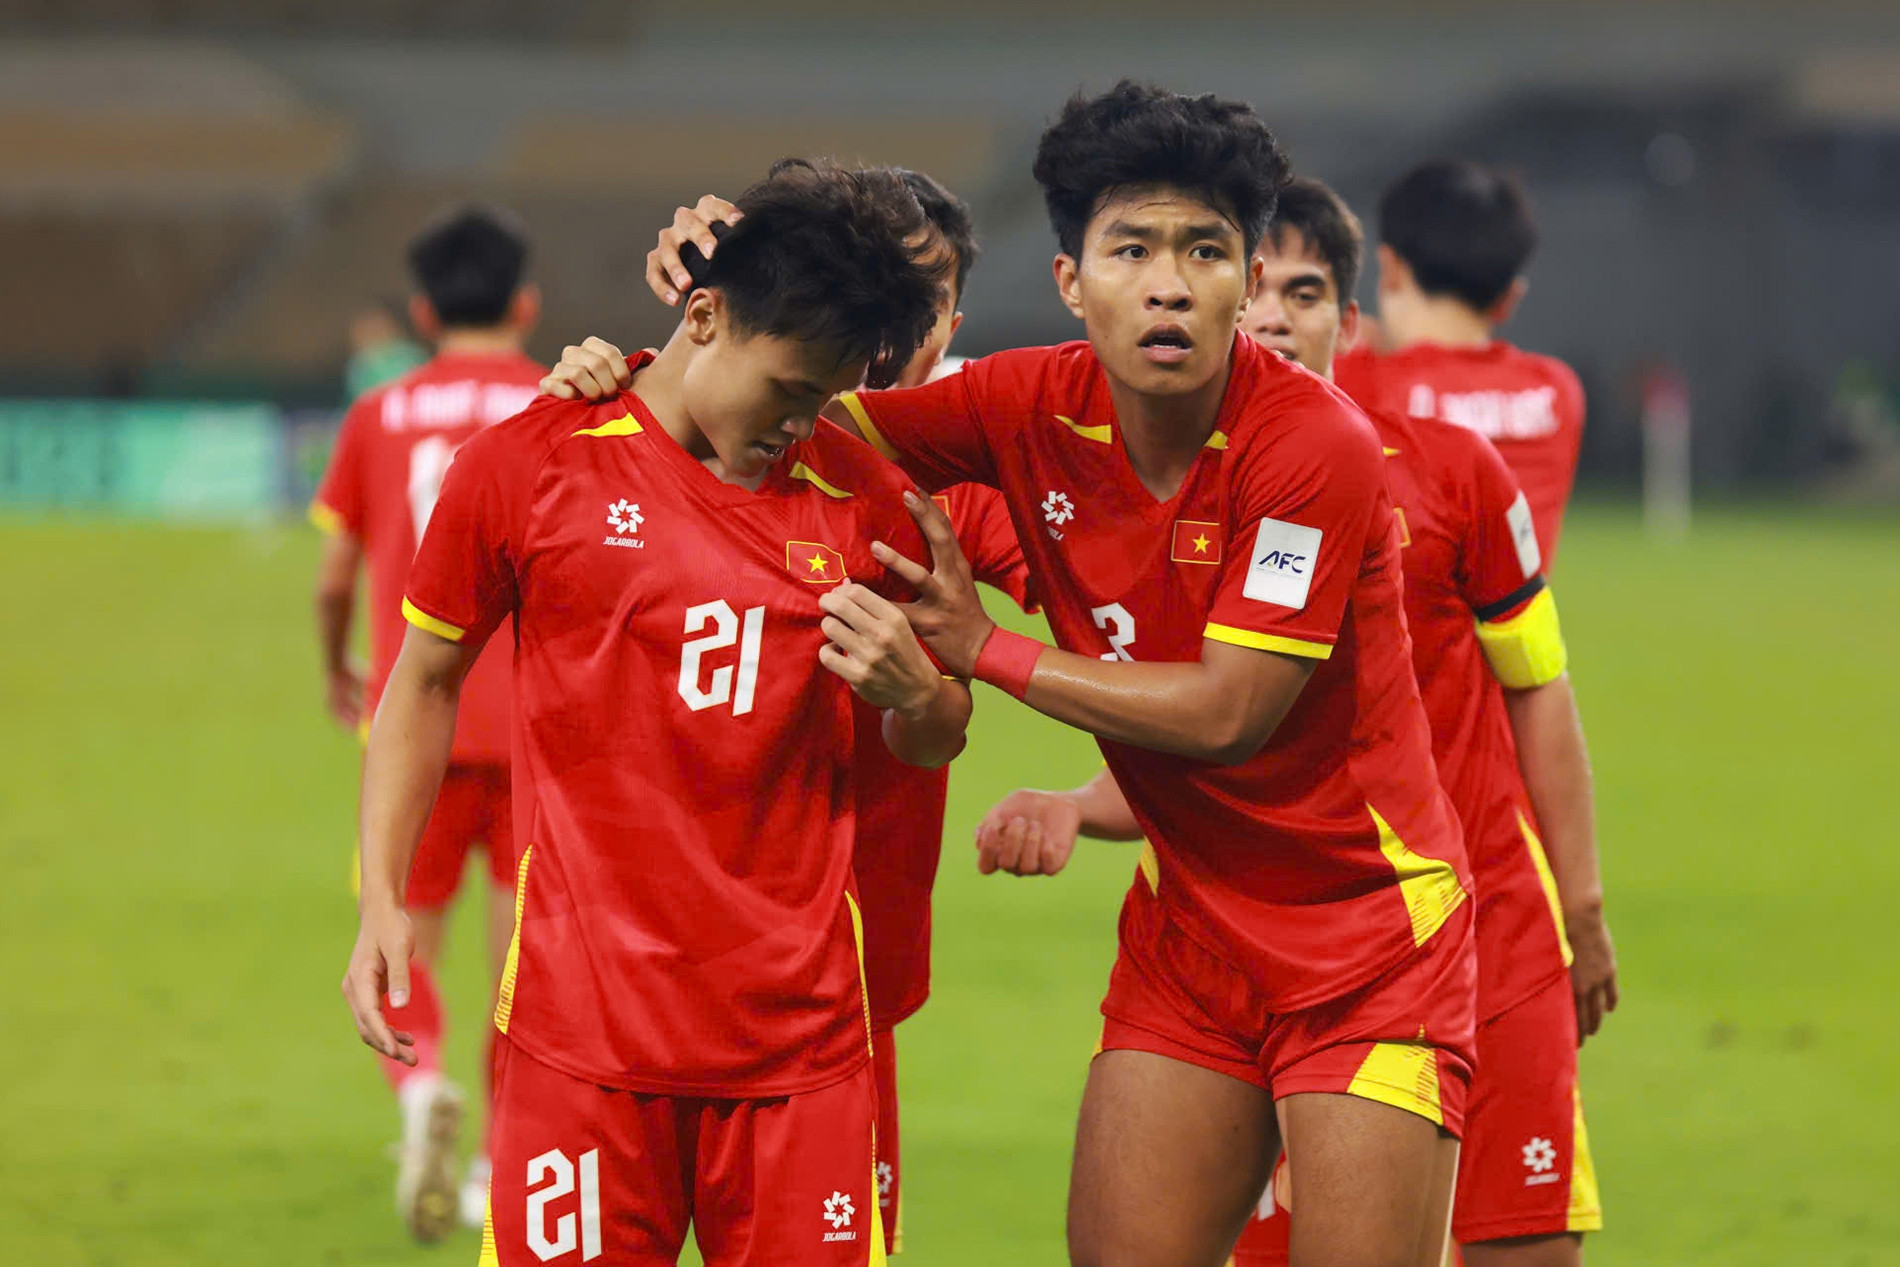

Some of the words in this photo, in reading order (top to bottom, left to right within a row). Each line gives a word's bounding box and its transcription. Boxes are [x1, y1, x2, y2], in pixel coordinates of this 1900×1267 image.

[1258, 550, 1306, 574] AFC
[678, 599, 765, 717] 21
[1091, 602, 1136, 662] 3
[526, 1148, 602, 1263] 21
